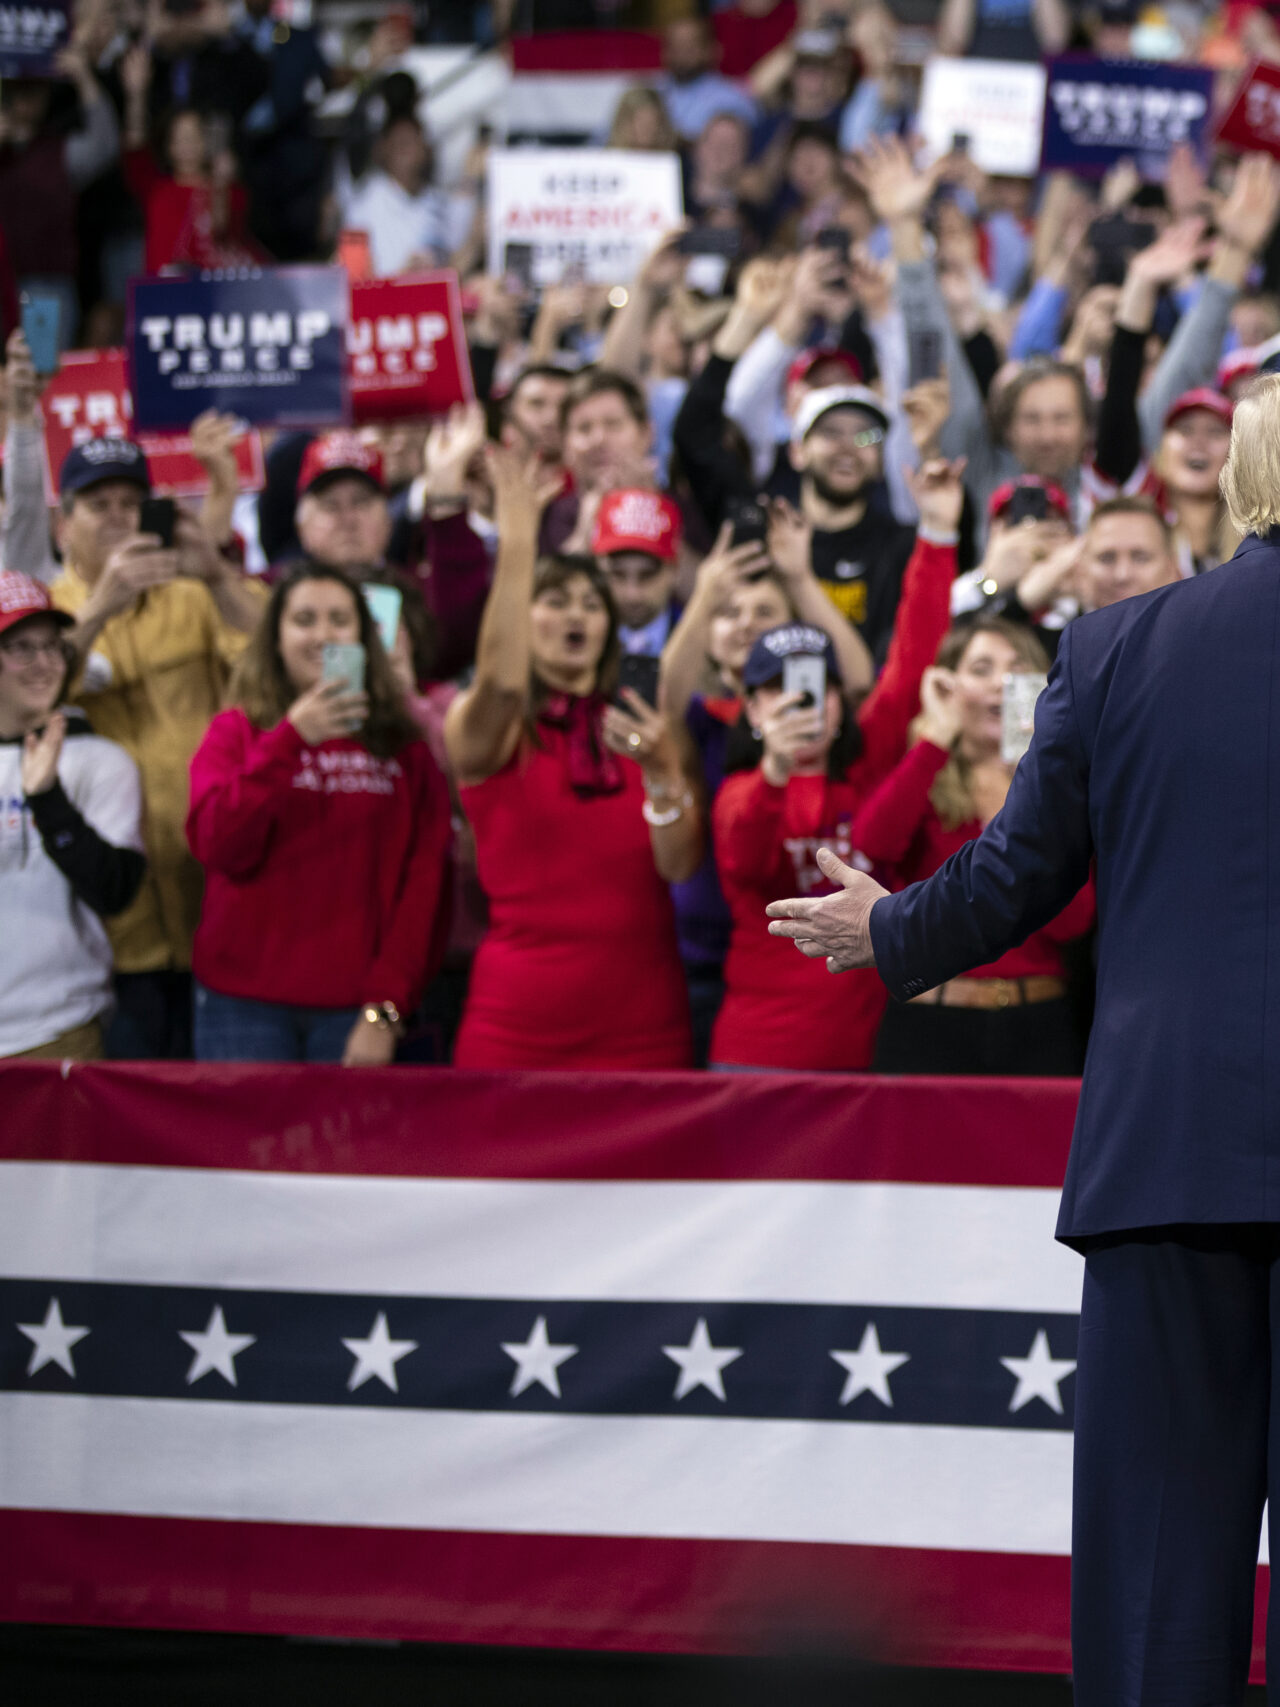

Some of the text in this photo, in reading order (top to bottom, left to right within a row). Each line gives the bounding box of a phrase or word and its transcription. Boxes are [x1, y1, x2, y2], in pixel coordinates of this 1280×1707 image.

[141, 310, 330, 351] TRUMP
[348, 312, 448, 353] UMP
[159, 348, 314, 374] PENCE
[354, 349, 437, 374] NCE
